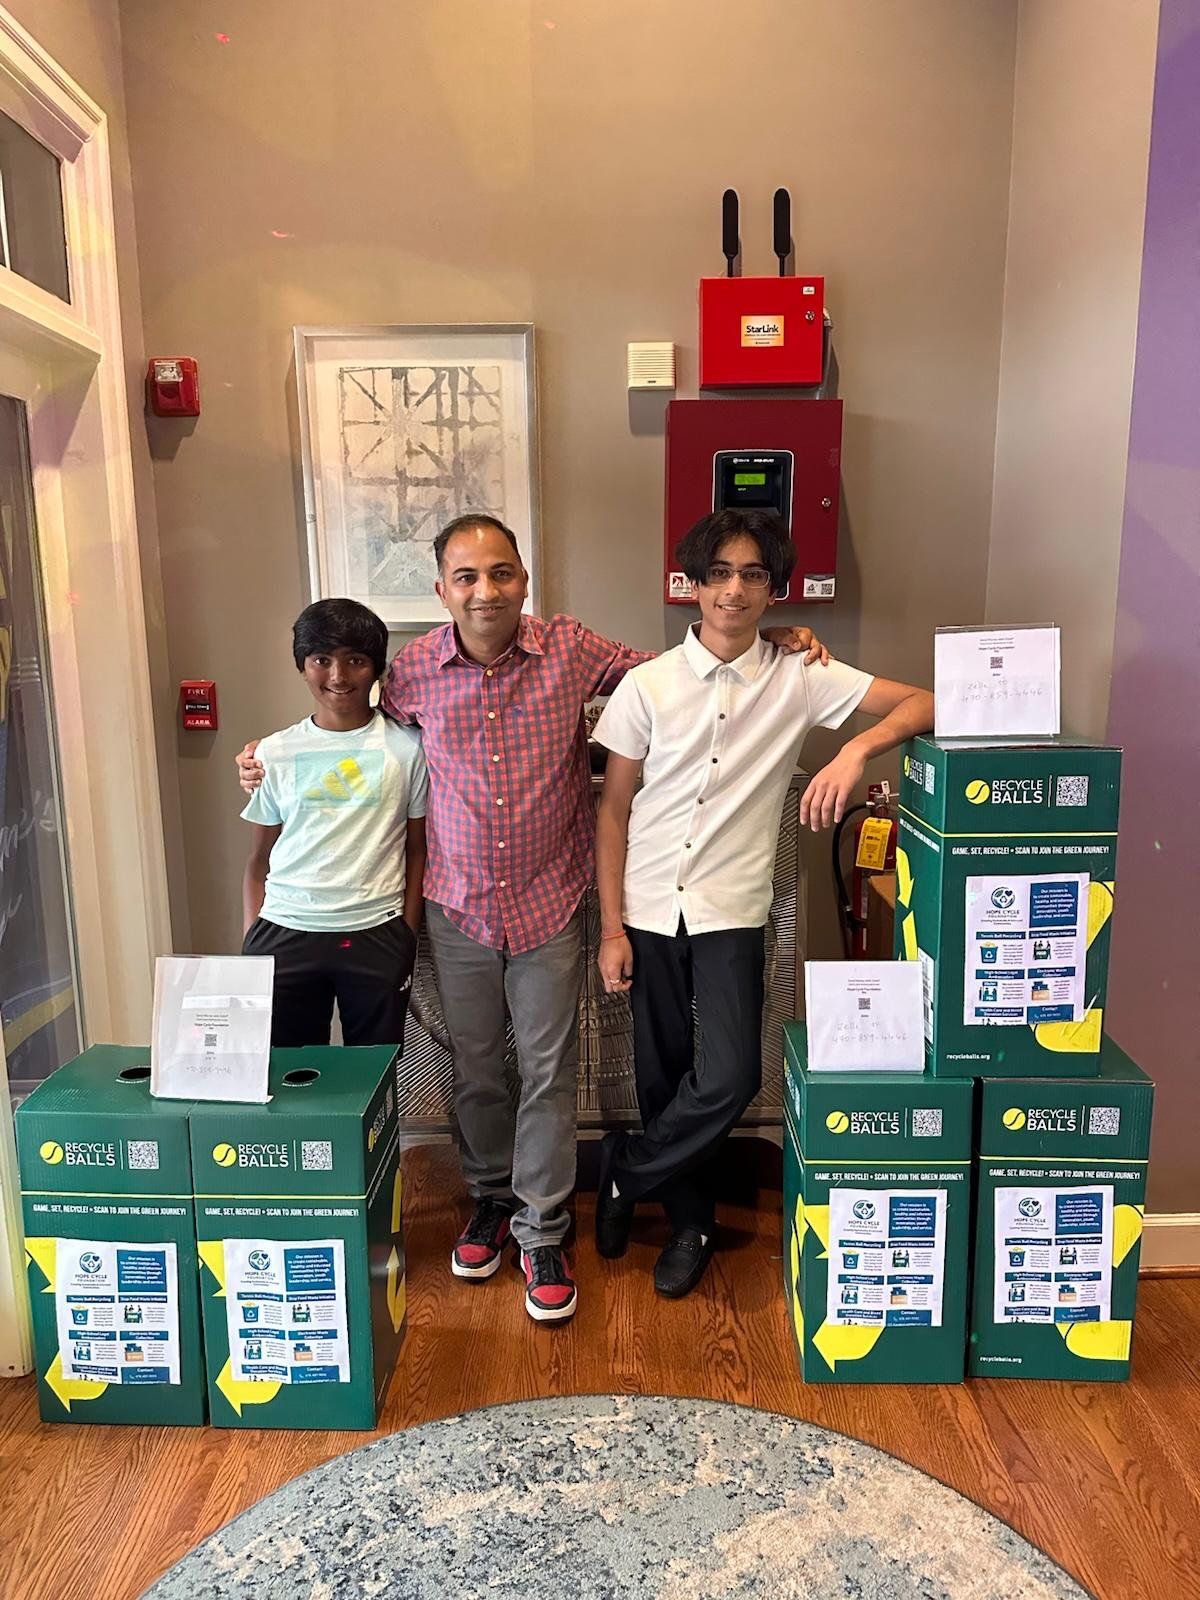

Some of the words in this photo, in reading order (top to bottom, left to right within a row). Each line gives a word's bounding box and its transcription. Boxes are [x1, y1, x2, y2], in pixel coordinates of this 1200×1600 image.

[746, 324, 778, 332] StarLink
[992, 780, 1043, 790] RECYCLE
[992, 791, 1043, 804] BALLS
[1052, 846, 1063, 854] THE
[1083, 846, 1109, 854] JOURNEY!
[851, 1112, 899, 1122] RECYCLE
[1028, 1109, 1076, 1119] RECYCLE
[851, 1123, 899, 1134] BALLS
[1027, 1119, 1076, 1131] BALLS
[65, 1142, 114, 1153] RECYCLE
[238, 1144, 288, 1154] RECYCLE
[66, 1154, 116, 1166] BALLS
[238, 1155, 289, 1167] BALLS
